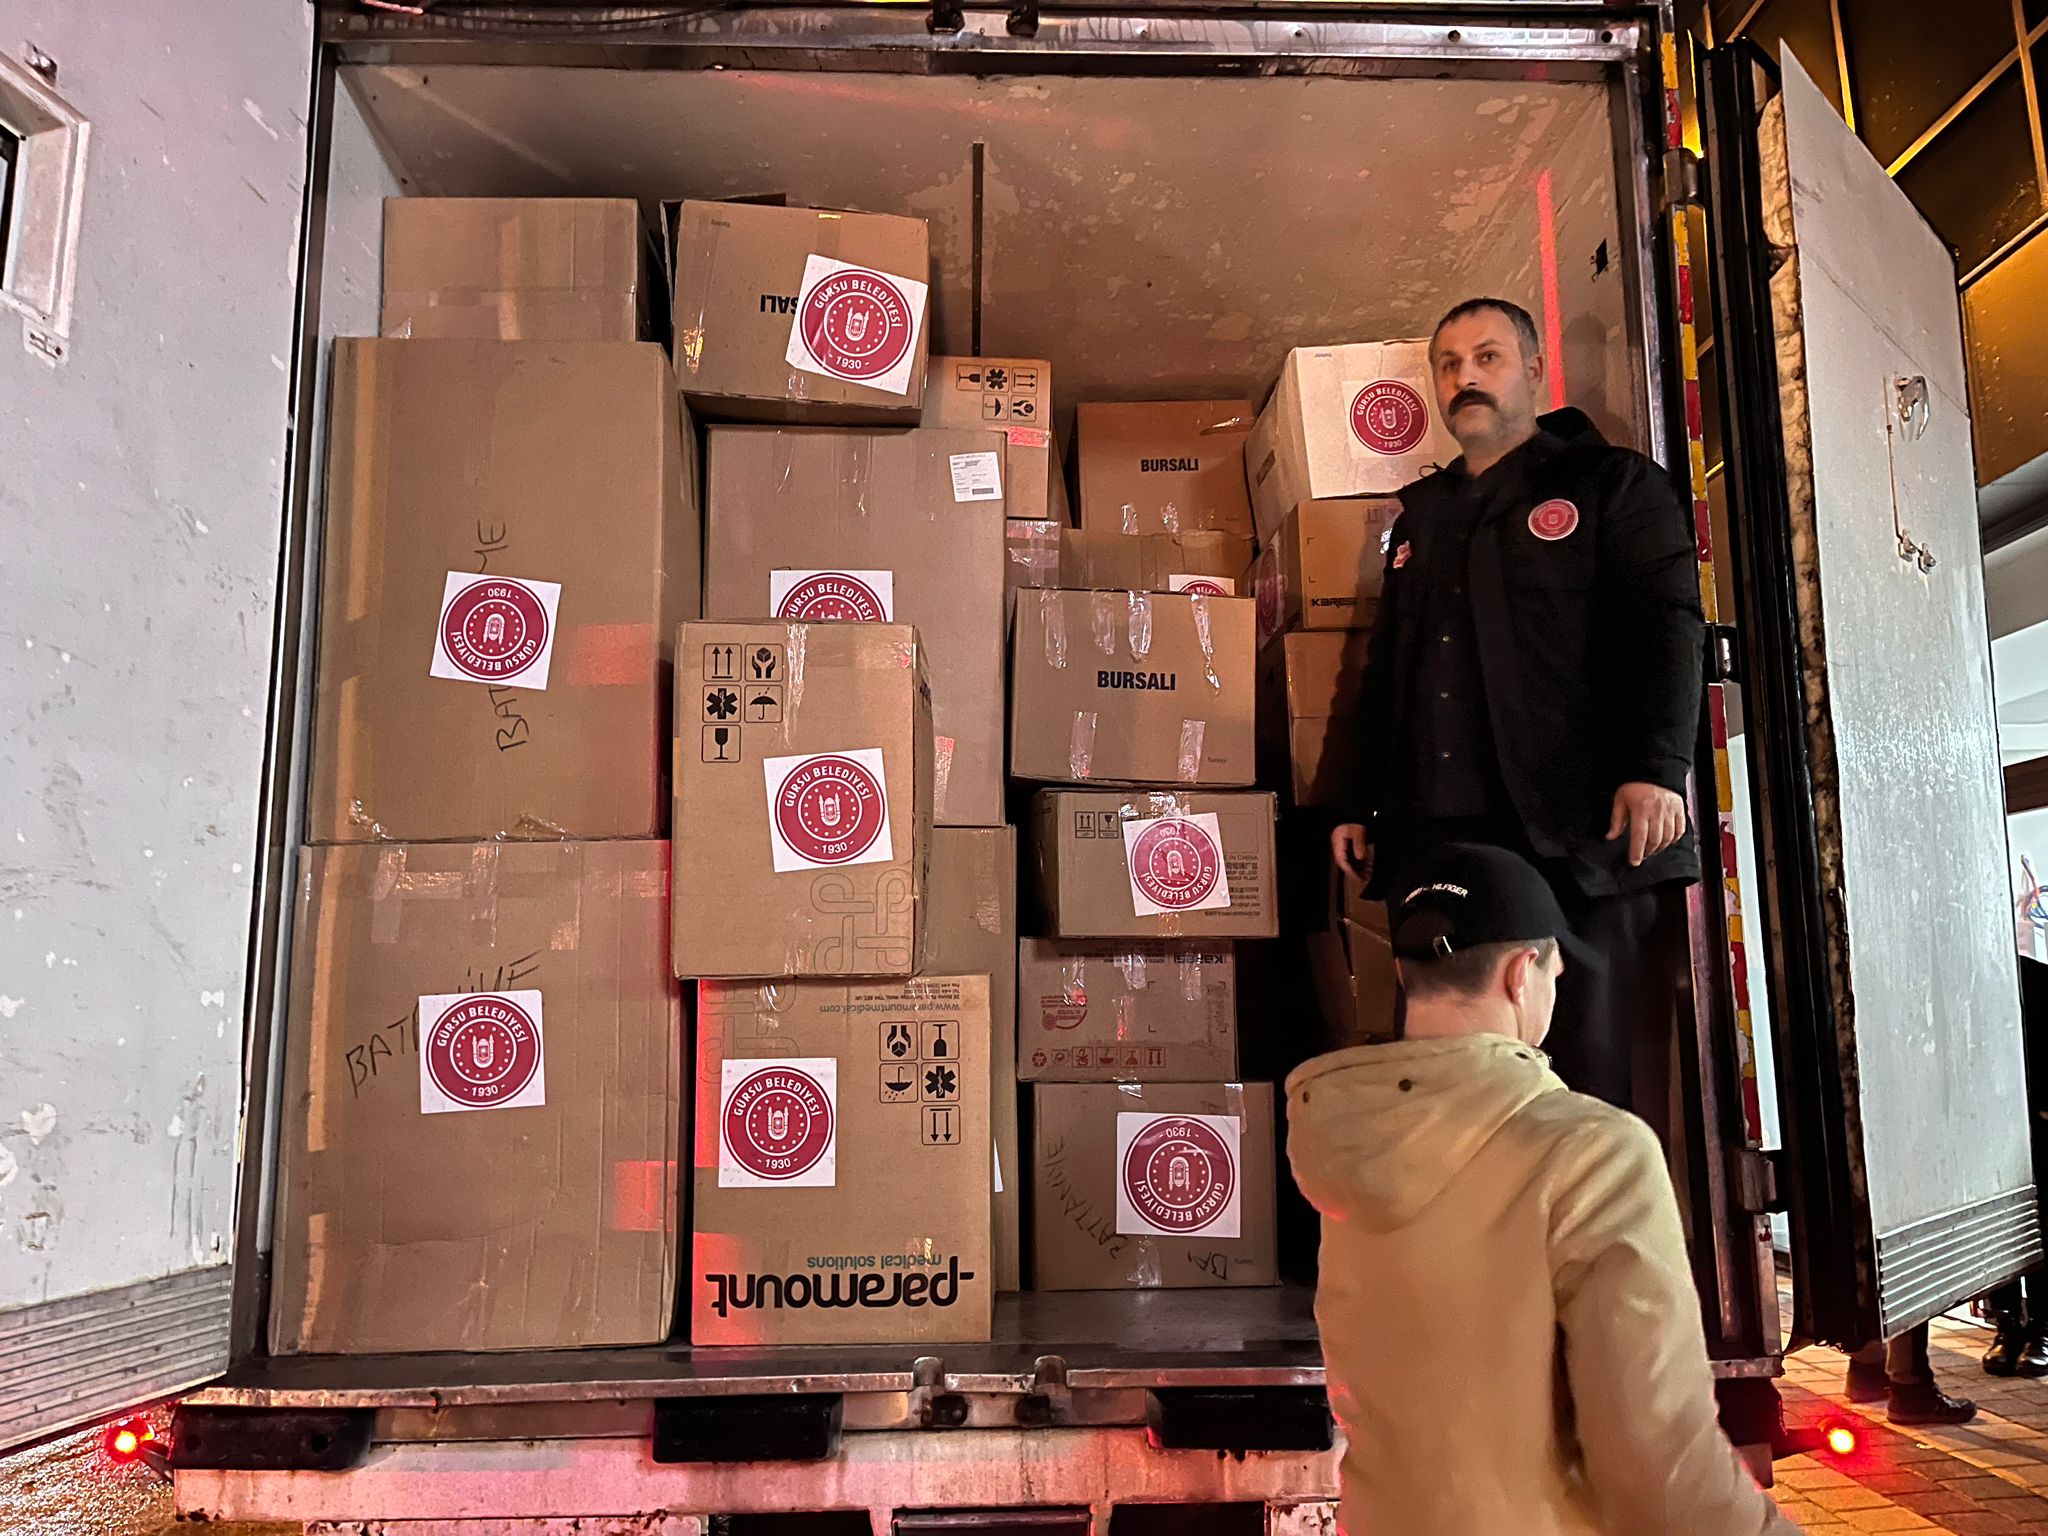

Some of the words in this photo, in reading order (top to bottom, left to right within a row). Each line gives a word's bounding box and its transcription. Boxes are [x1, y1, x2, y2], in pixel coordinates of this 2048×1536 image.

[814, 280, 848, 309] GÜRSU
[851, 279, 903, 328] BELEDİYESİ
[836, 356, 862, 370] 1930
[1356, 391, 1376, 416] GÜRSU
[1376, 386, 1419, 412] BELEDİYESİ
[1383, 439, 1402, 449] 1930
[1141, 459, 1199, 473] BURSALI
[487, 588, 512, 599] 1930
[817, 582, 876, 620] BELEDİYESİ
[450, 630, 502, 671] BELEDİYESİ
[506, 639, 537, 669] GÜRSU
[1097, 670, 1176, 691] BURSALI
[784, 769, 812, 807] GÜRSU
[812, 766, 873, 801] BELEDİYESİ
[1160, 827, 1181, 838] 1930
[821, 841, 848, 854] 1930
[1141, 872, 1191, 900] BELEDİYESİ
[819, 1002, 960, 1014] www.paramountmedical.com
[437, 1011, 466, 1047] GÜRSU
[468, 1006, 529, 1042] BELEDİYESİ
[471, 1084, 499, 1097] 1930
[733, 1081, 764, 1117] GÜRSU
[765, 1077, 823, 1118] BELEDİYESİ
[1165, 1126, 1191, 1138] 1930
[765, 1157, 792, 1170] 1930
[1134, 1180, 1193, 1222] BELEDİYESİ
[1195, 1182, 1225, 1218] GÜRSU
[807, 1256, 877, 1269] solutions
[880, 1256, 942, 1269] medical
[705, 1256, 975, 1318] paramount
